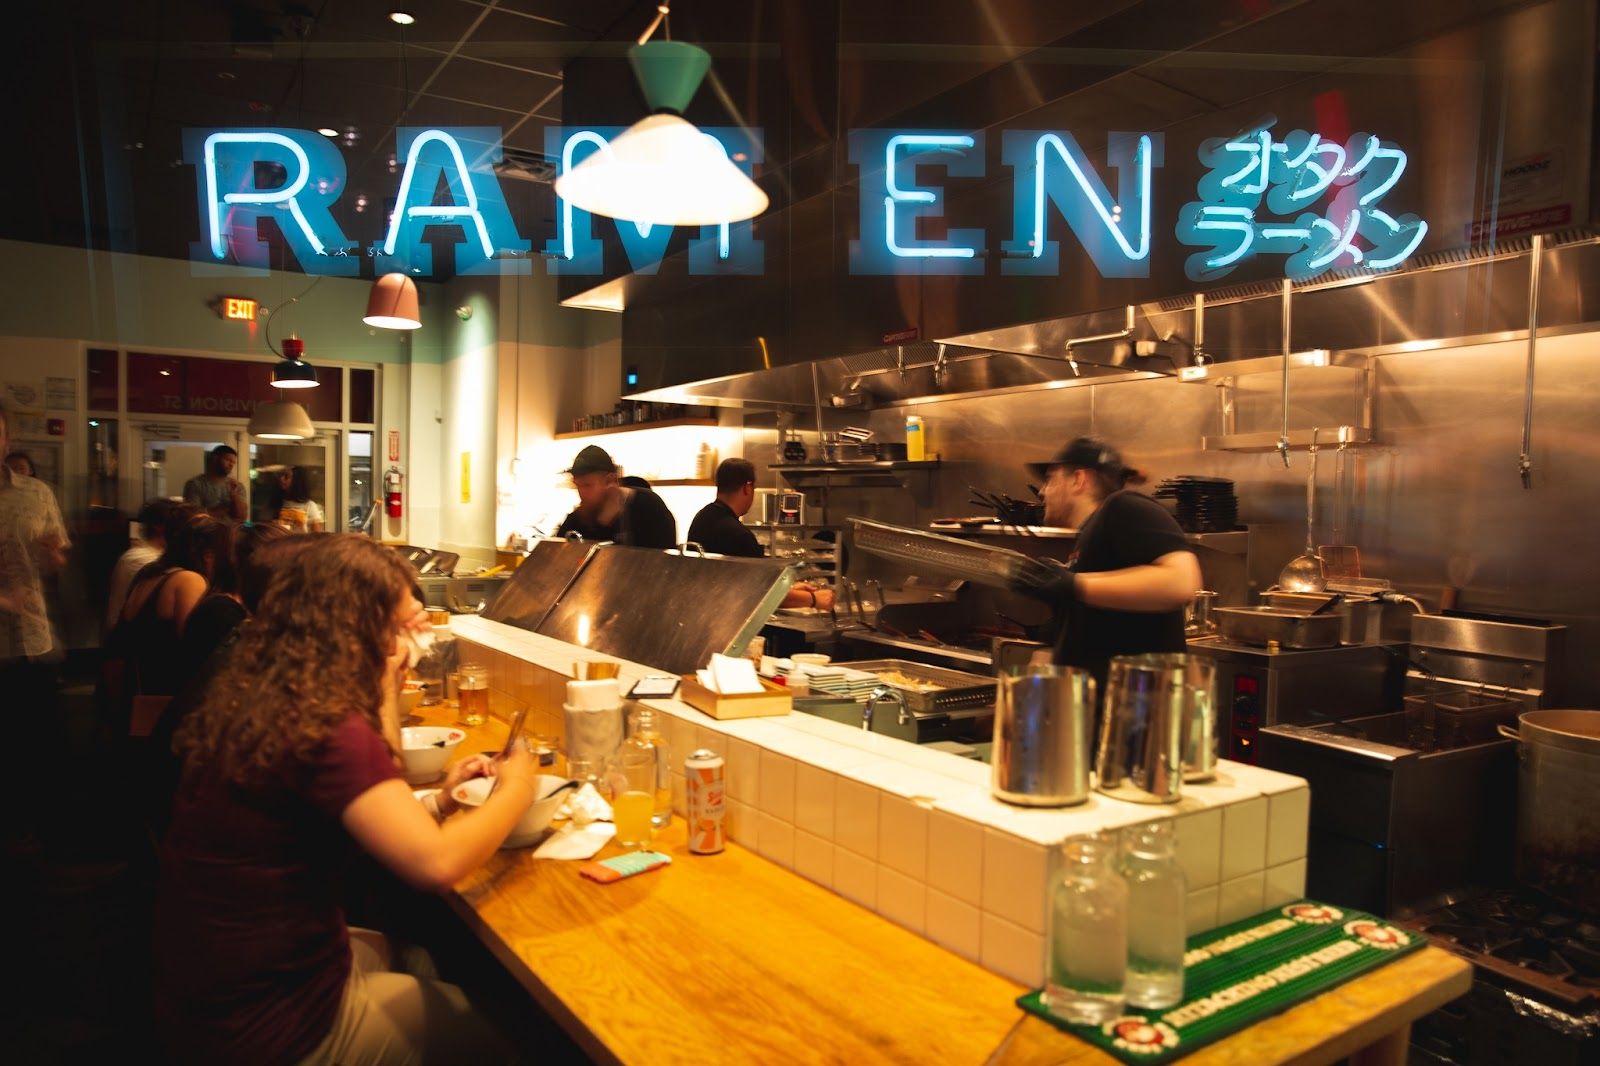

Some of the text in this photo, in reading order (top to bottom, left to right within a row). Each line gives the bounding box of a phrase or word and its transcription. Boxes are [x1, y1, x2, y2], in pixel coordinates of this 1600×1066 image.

[1206, 129, 1409, 208] オタク
[1186, 205, 1428, 274] ラーメン
[229, 298, 255, 320] EXIT
